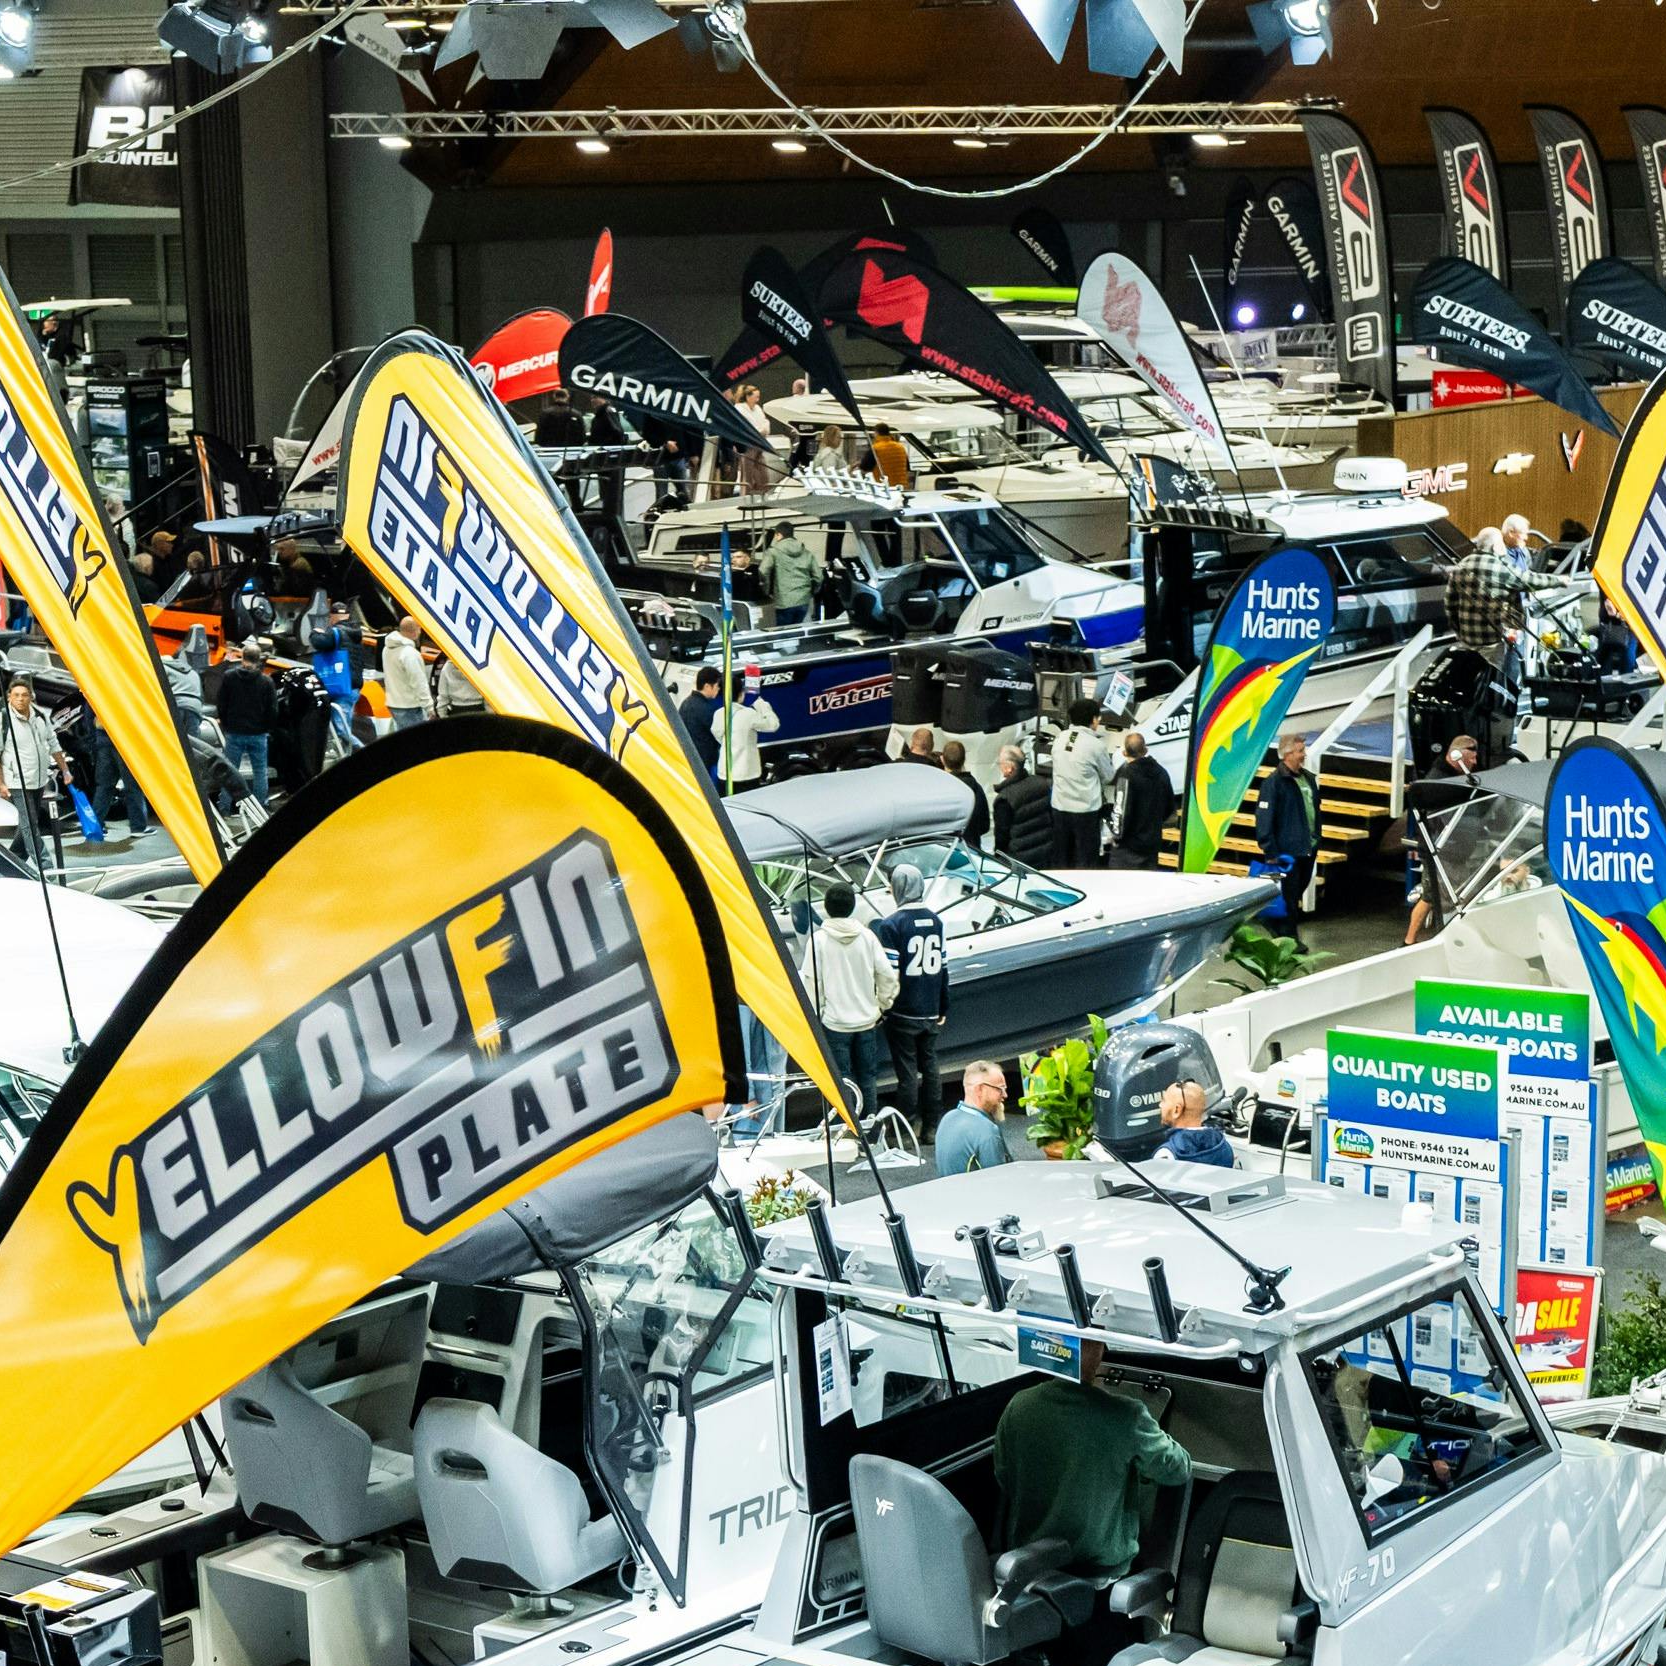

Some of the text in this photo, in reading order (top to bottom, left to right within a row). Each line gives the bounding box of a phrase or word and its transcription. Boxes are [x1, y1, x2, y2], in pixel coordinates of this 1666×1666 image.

[1019, 229, 1059, 272] GARMIN
[1268, 196, 1320, 281] GARMIN
[750, 281, 813, 339] SURTEES
[1424, 295, 1532, 350] SURTEES
[1439, 326, 1506, 360] BUILT TO FISH
[1596, 332, 1664, 369] BUILT TO FISH
[497, 350, 559, 381] MERCUR
[570, 363, 711, 422] GARMIN
[921, 345, 1068, 432] www.stabicraft.com
[1135, 352, 1215, 438] www.stabicraft.com
[1453, 383, 1504, 395] JEANNEAU
[1401, 462, 1468, 498] GMC
[1247, 579, 1320, 610] Hunts
[1241, 609, 1321, 640] Marine
[983, 678, 1034, 691] MERCURY
[1565, 795, 1649, 839] Hunts
[1563, 838, 1654, 884] Marine
[905, 934, 941, 976] 26
[1439, 1004, 1563, 1034] AVAILABLE
[1507, 1038, 1578, 1062] BOATS
[68, 838, 636, 1343] YELLOWFIN
[1333, 1054, 1492, 1094] QUALITY USED
[1510, 1084, 1560, 1097] 9546 1324
[427, 1028, 646, 1196] PLATE
[1376, 1090, 1447, 1115] BOATS
[1341, 1130, 1369, 1143] Hunts
[1381, 1137, 1470, 1157] PHONE: 9546 1324
[1381, 1149, 1495, 1173] HUNTSMARINE.COM.AU
[1614, 1162, 1653, 1185] Marine
[1536, 1297, 1582, 1331] SALE
[1030, 1339, 1049, 1354] SAVE
[820, 1570, 859, 1593] ARMIN
